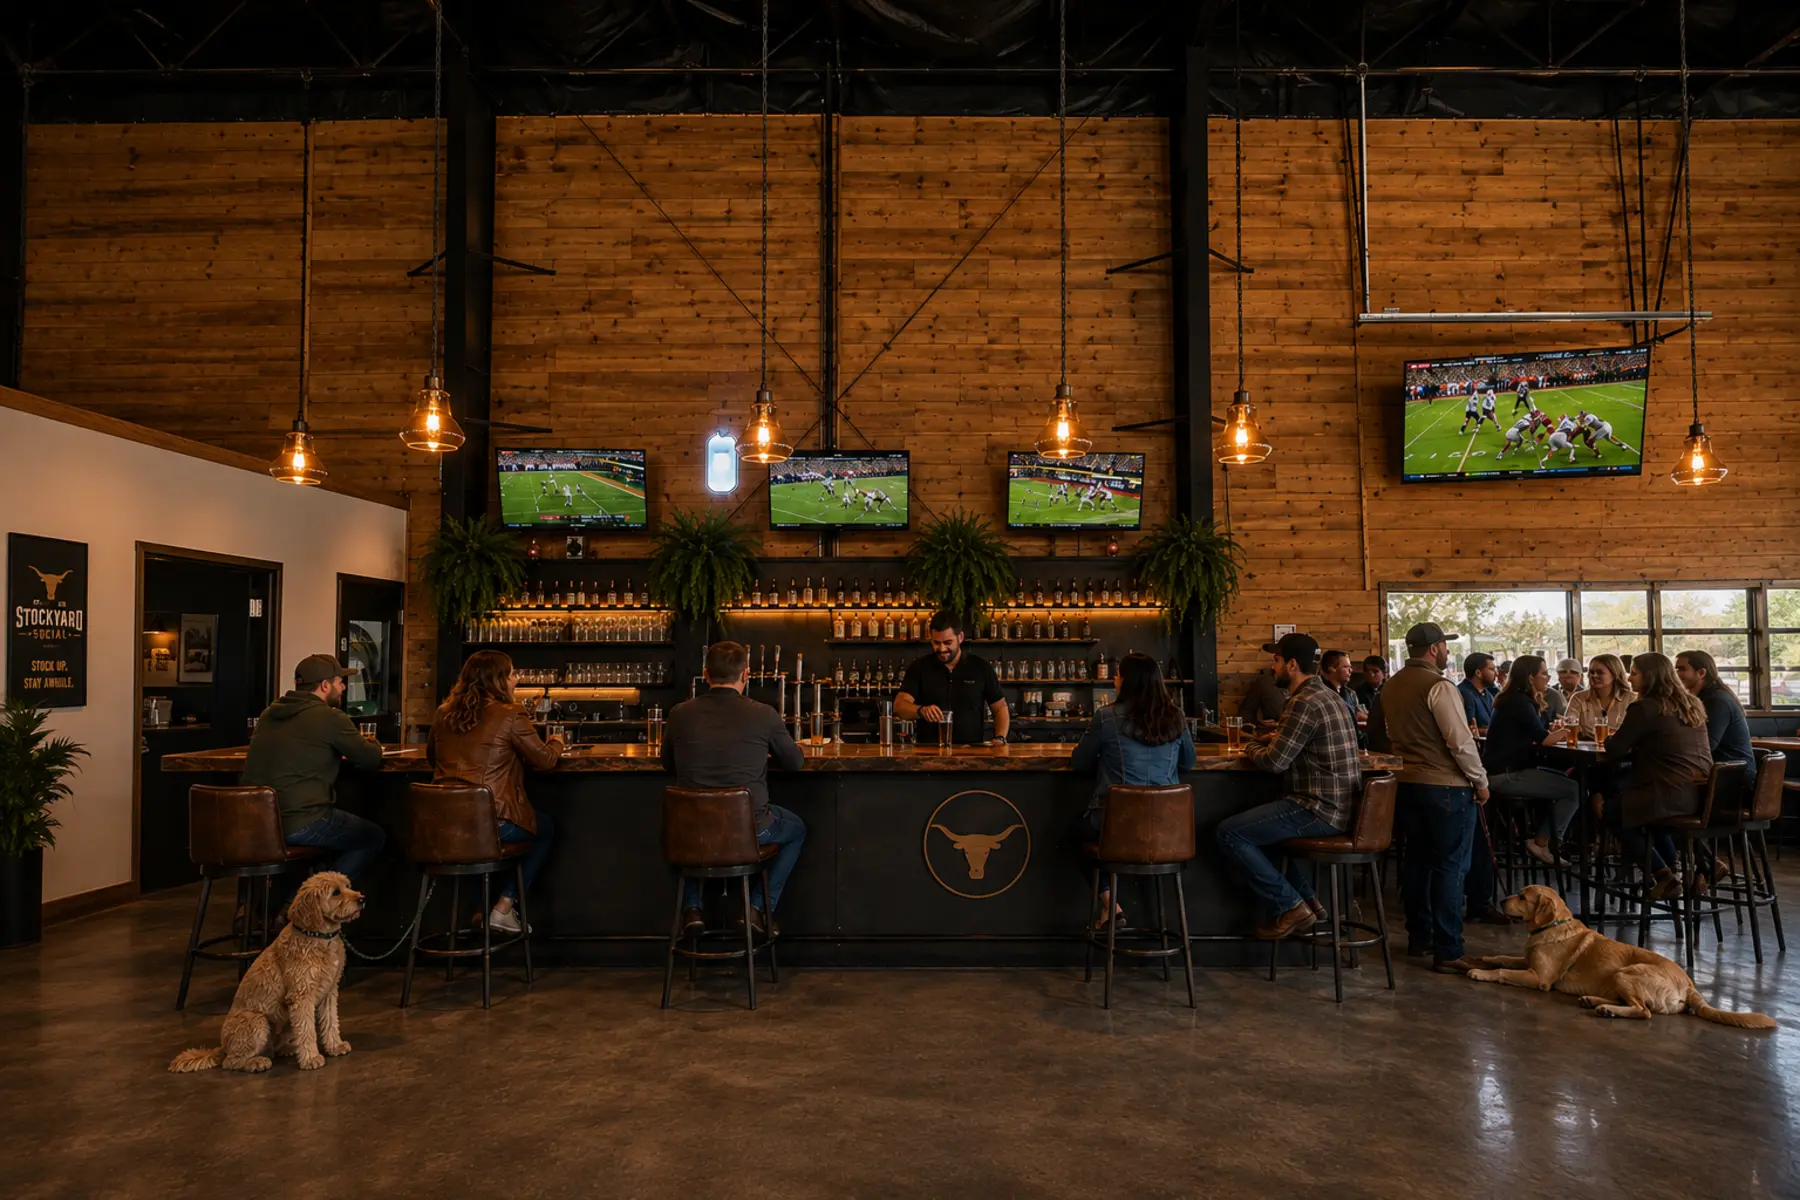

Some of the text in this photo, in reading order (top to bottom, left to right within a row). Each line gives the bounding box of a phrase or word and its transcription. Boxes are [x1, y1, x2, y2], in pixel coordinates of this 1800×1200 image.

[16, 606, 83, 631] STOCKYARD
[33, 629, 67, 639] SOCIAL
[31, 660, 68, 671] STOCK UP.
[23, 677, 42, 689] STAY
